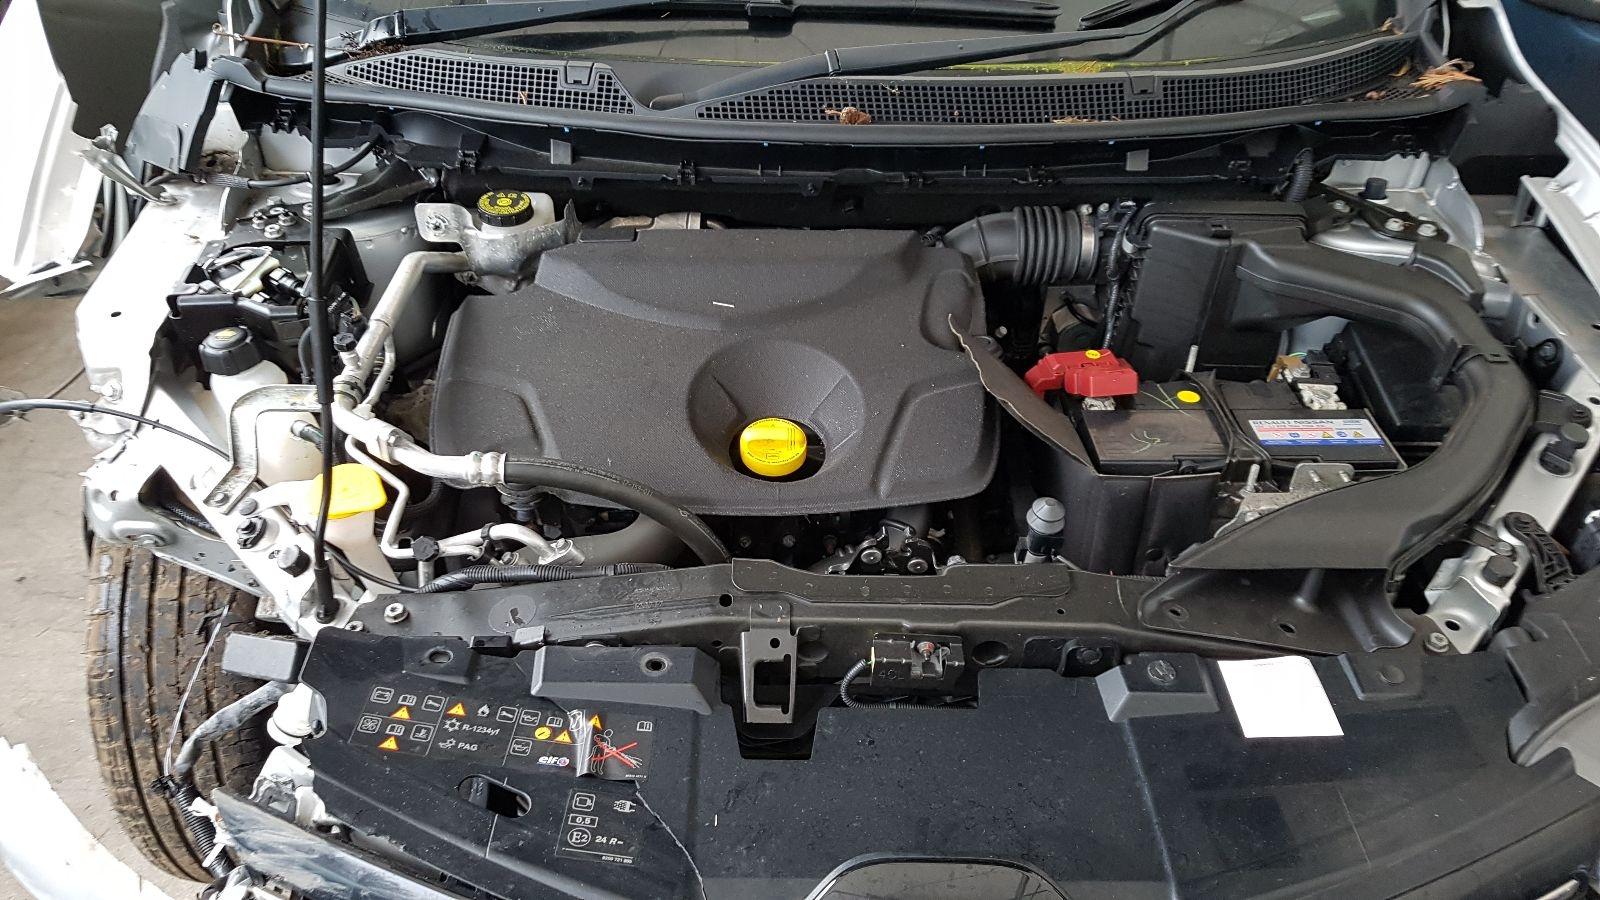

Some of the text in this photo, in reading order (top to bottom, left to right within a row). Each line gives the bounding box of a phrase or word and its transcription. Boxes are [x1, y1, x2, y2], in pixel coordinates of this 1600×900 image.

[461, 723, 501, 736] R-1234yf
[457, 742, 478, 751] PAG
[576, 816, 591, 825] 0,5
[571, 831, 588, 843] E2
[595, 835, 608, 843] 24
